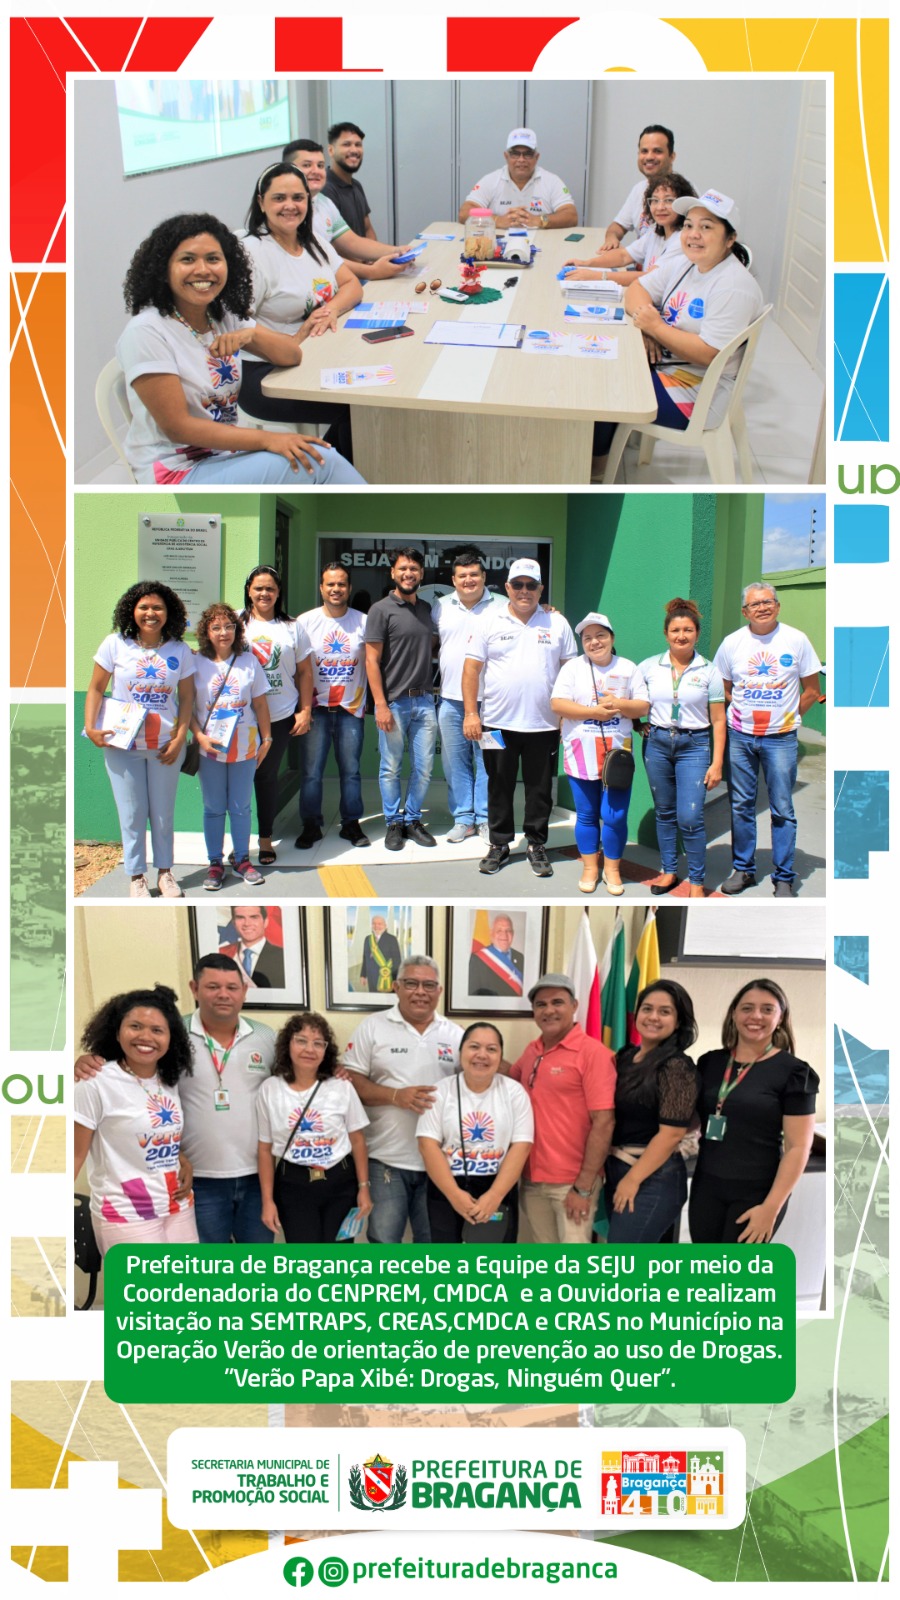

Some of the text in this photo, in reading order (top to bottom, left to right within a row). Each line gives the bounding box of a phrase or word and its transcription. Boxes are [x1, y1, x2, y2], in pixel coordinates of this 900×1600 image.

[340, 552, 391, 567] SEJA
[318, 667, 355, 676] 2023
[132, 692, 169, 704] 2023
[743, 689, 783, 700] 2023
[291, 1146, 334, 1160] 2023
[450, 1159, 499, 1174] 2023
